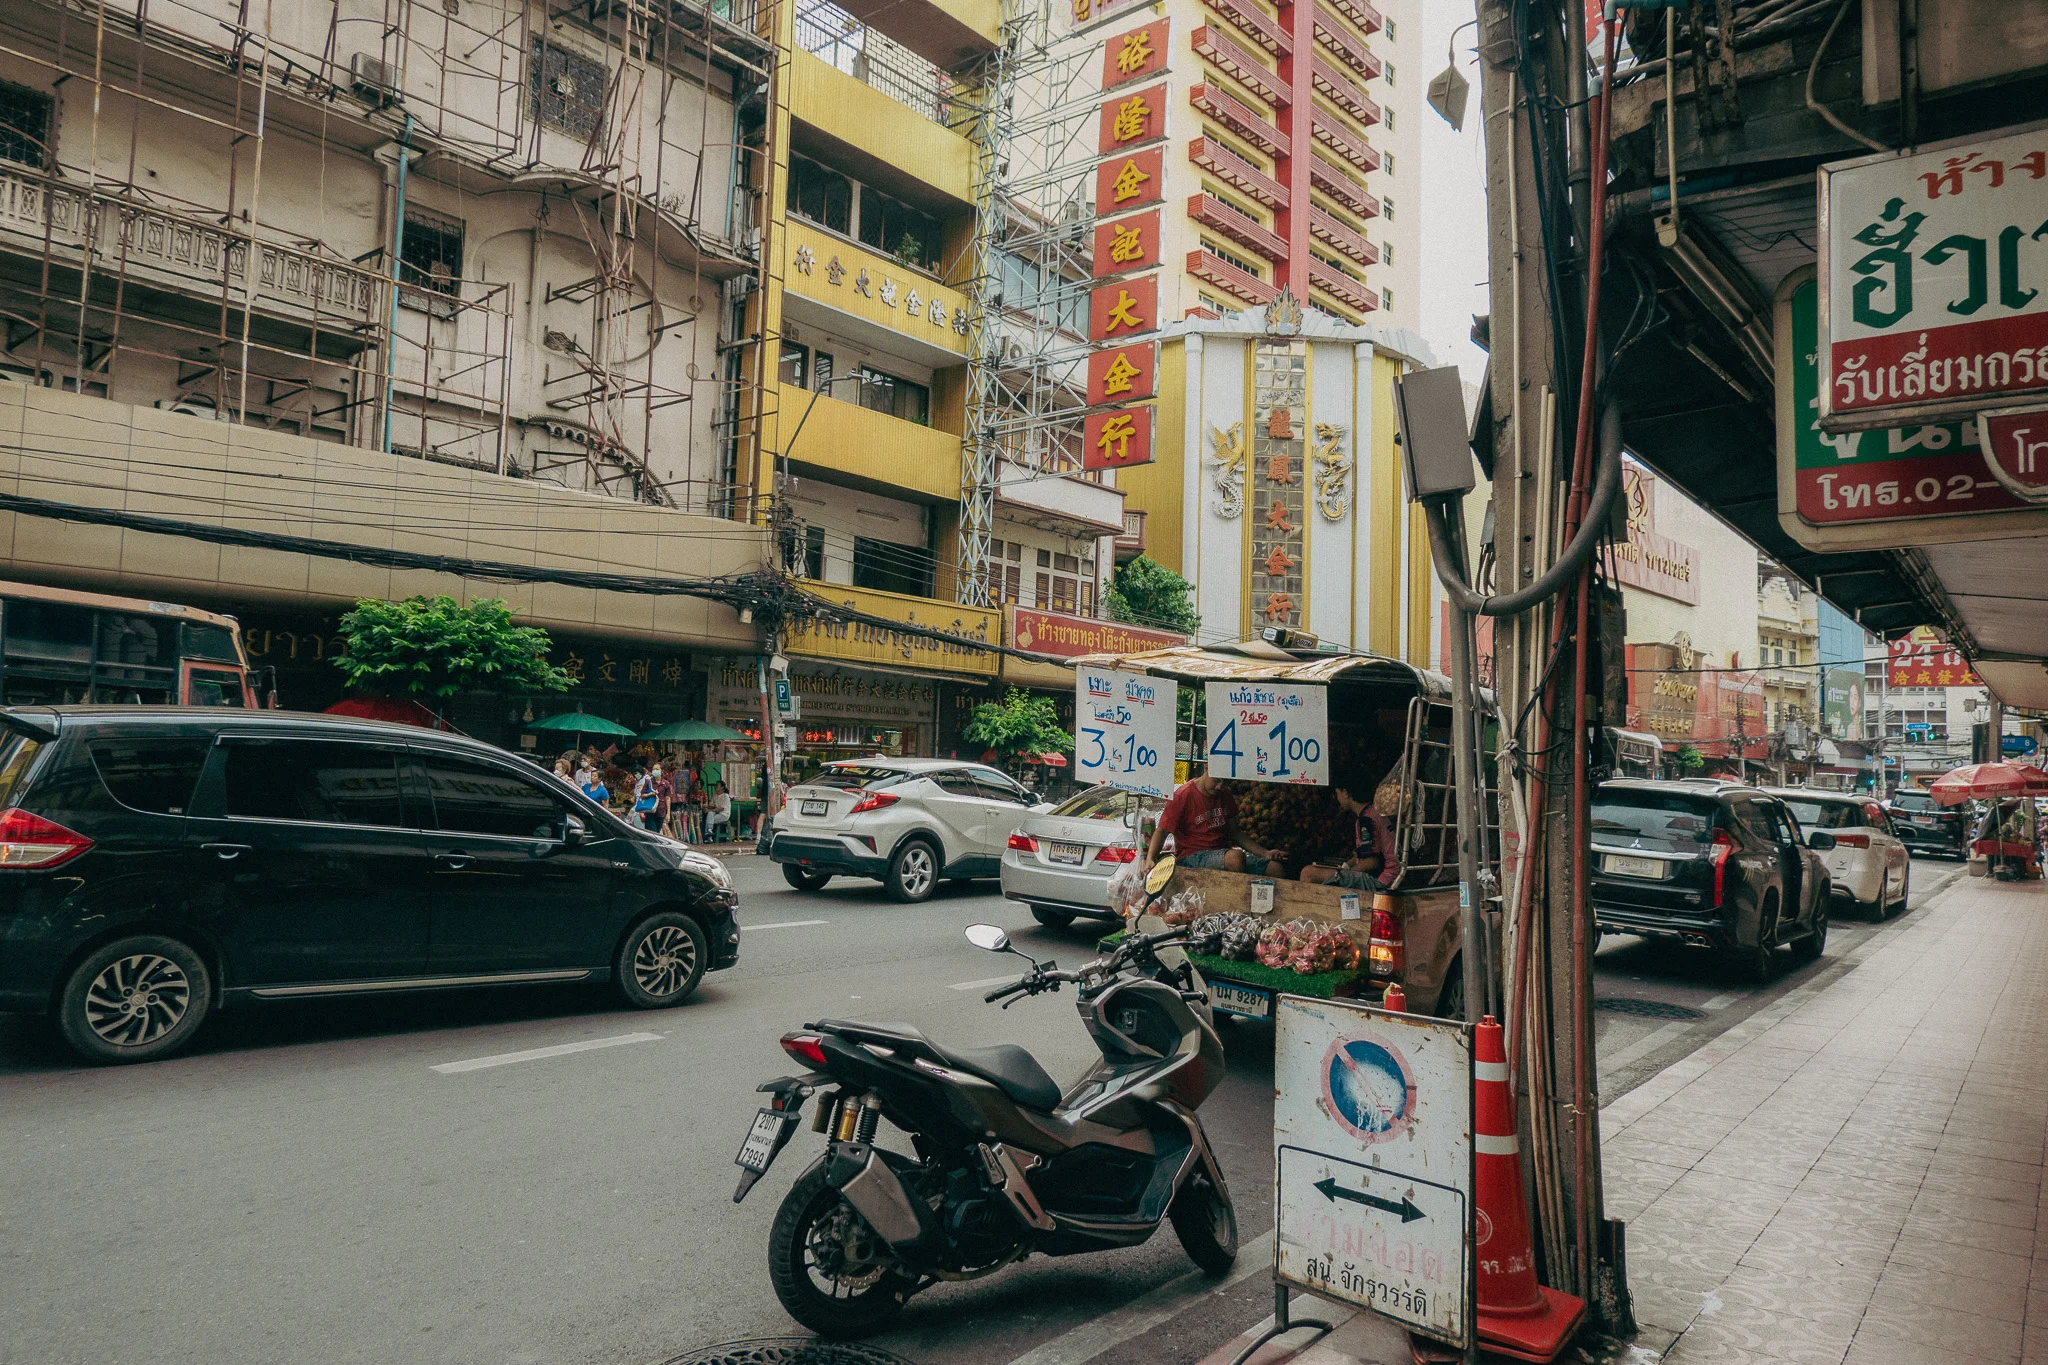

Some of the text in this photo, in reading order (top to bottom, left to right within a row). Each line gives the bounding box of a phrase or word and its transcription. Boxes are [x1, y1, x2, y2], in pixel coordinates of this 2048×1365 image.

[1917, 152, 2046, 200] ห้าง
[1265, 408, 1294, 622] 龍鳳大金行
[779, 685, 786, 698] P
[1088, 677, 1155, 707] เงาะ มังคุด
[1229, 686, 1252, 703] แก้ว
[1116, 706, 1131, 724] 50
[1081, 727, 1105, 768] 3
[1123, 734, 1157, 773] 100
[1210, 719, 1244, 777] 4
[1269, 720, 1320, 777] 100
[2024, 739, 2031, 747] 8
[1236, 989, 1264, 1006] 9287
[741, 1147, 765, 1167] 7999
[1307, 1257, 1427, 1317] สน. จักรวรรดิ
